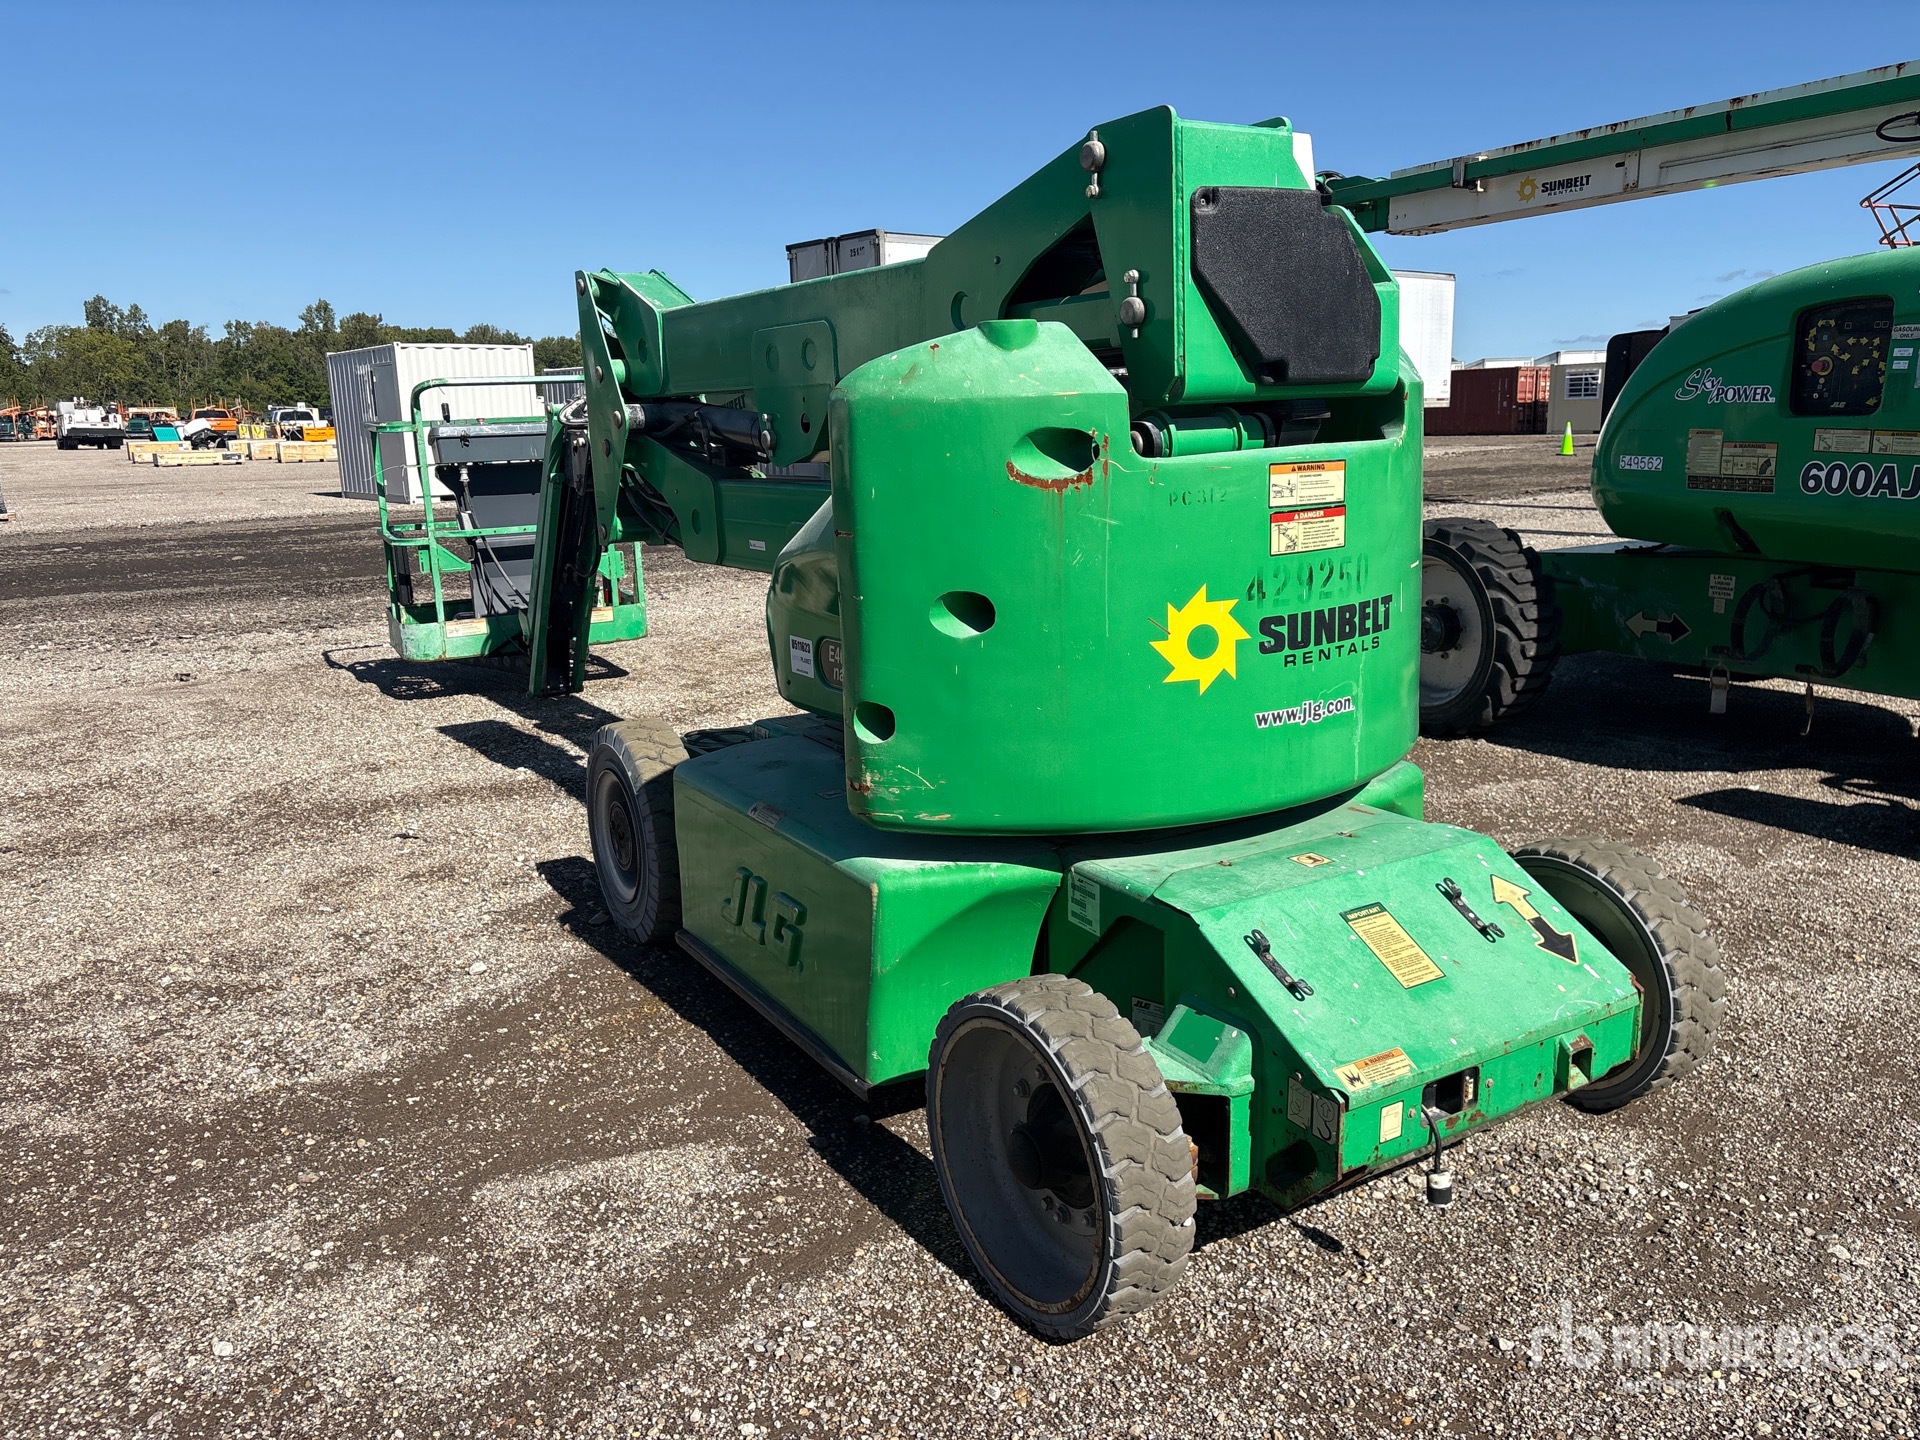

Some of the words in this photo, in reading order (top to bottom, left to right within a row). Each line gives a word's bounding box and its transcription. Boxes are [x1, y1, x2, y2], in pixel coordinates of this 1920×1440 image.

[1541, 174, 1591, 193] SUNBELT
[1547, 186, 1584, 197] RENTALS
[1893, 325, 1920, 333] GASOLIN
[1297, 463, 1326, 472] WARNING
[1620, 456, 1662, 470] 549562
[1299, 510, 1325, 519] DANGER
[1246, 553, 1369, 609] 429250
[1258, 594, 1393, 655] SUNBELT
[1284, 636, 1380, 668] RENTALS
[720, 866, 808, 968] JLG
[1346, 906, 1381, 920] IMPORTANT
[1133, 1000, 1152, 1010] JLG
[1369, 1052, 1395, 1064] WARNING
